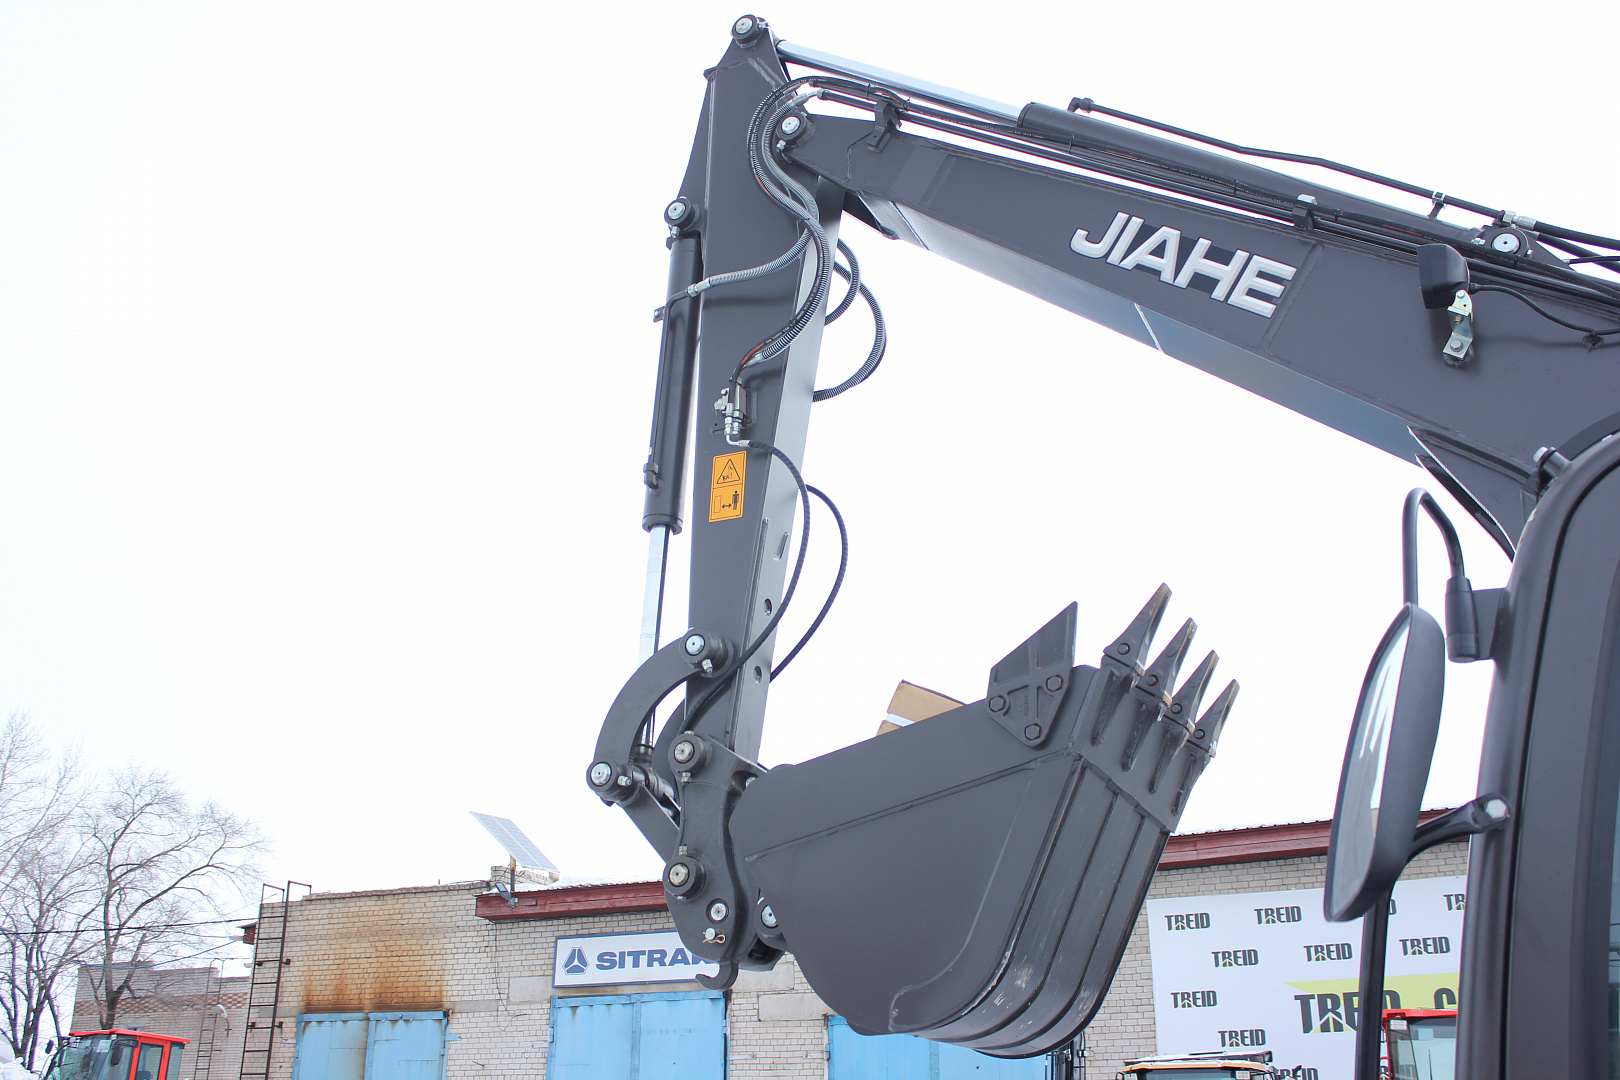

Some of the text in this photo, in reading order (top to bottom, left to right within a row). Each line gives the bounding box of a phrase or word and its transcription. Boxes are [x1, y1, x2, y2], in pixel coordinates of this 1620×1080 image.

[1070, 211, 1298, 319] JIAHE
[1165, 912, 1211, 931] TREID
[1254, 906, 1302, 925] TREID
[1304, 943, 1353, 962] TREID
[1399, 936, 1451, 956] TREID
[1212, 949, 1259, 968] TREID
[1171, 990, 1217, 1009] TREID
[1218, 1029, 1266, 1047] TREID
